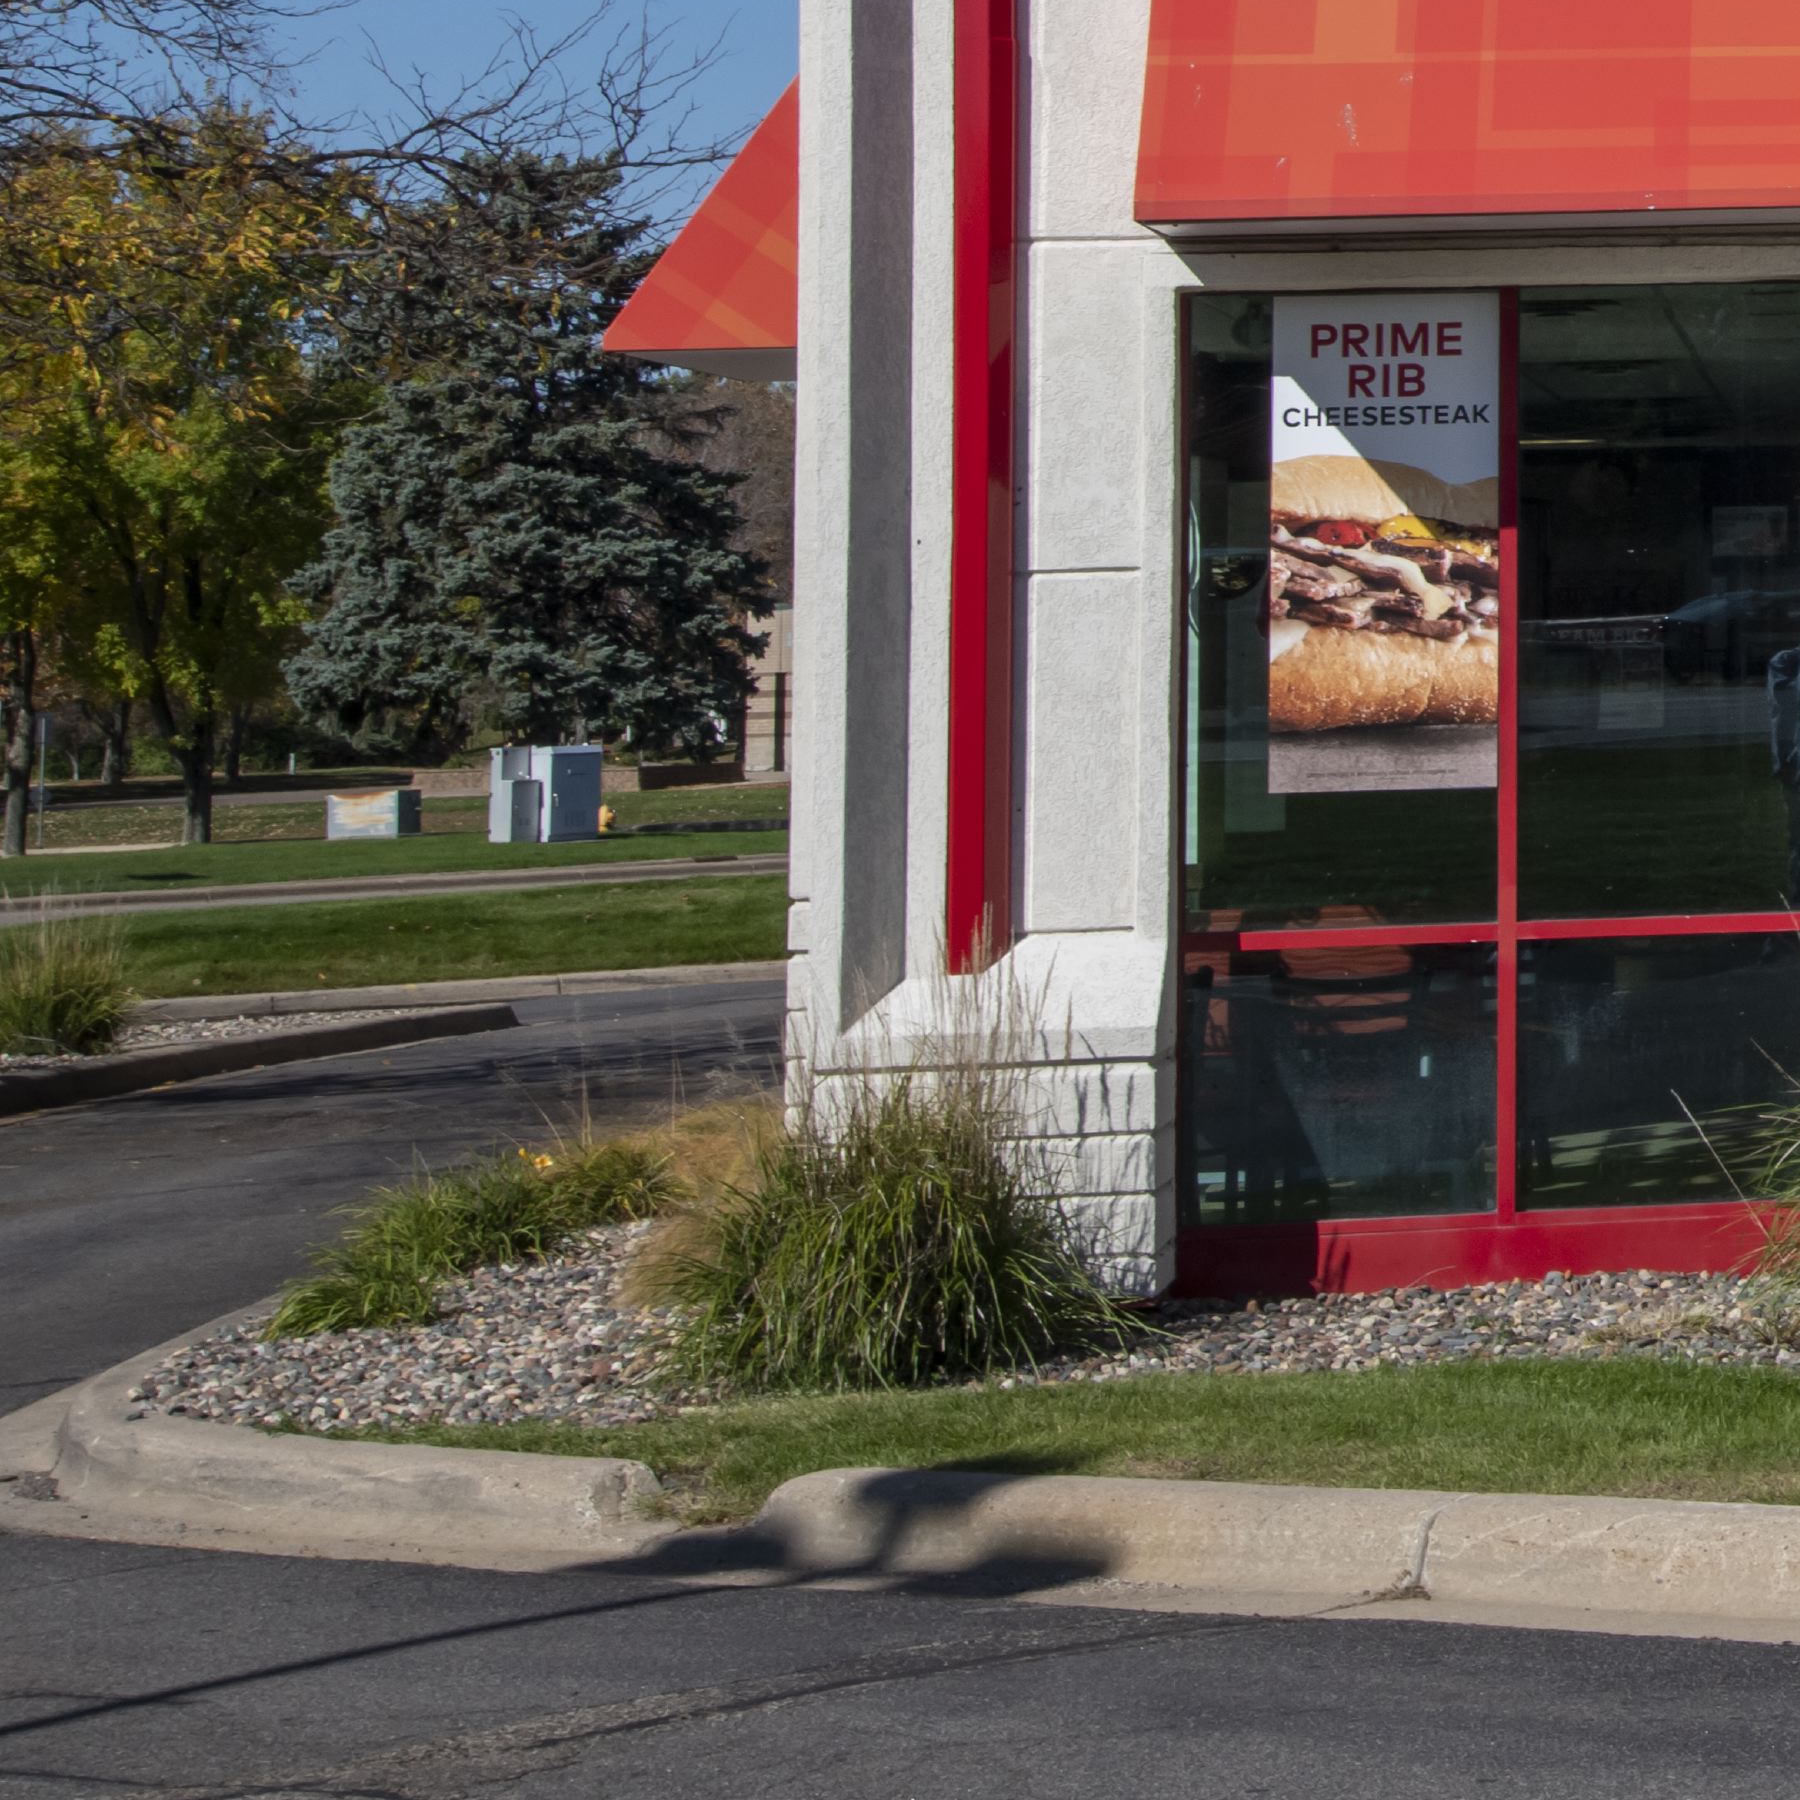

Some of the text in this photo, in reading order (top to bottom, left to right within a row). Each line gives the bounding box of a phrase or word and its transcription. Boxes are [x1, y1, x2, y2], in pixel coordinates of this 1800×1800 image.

[1308, 320, 1464, 360] PRIME
[1346, 362, 1427, 400] RIB
[1281, 403, 1492, 430] CHEESESTEAK
